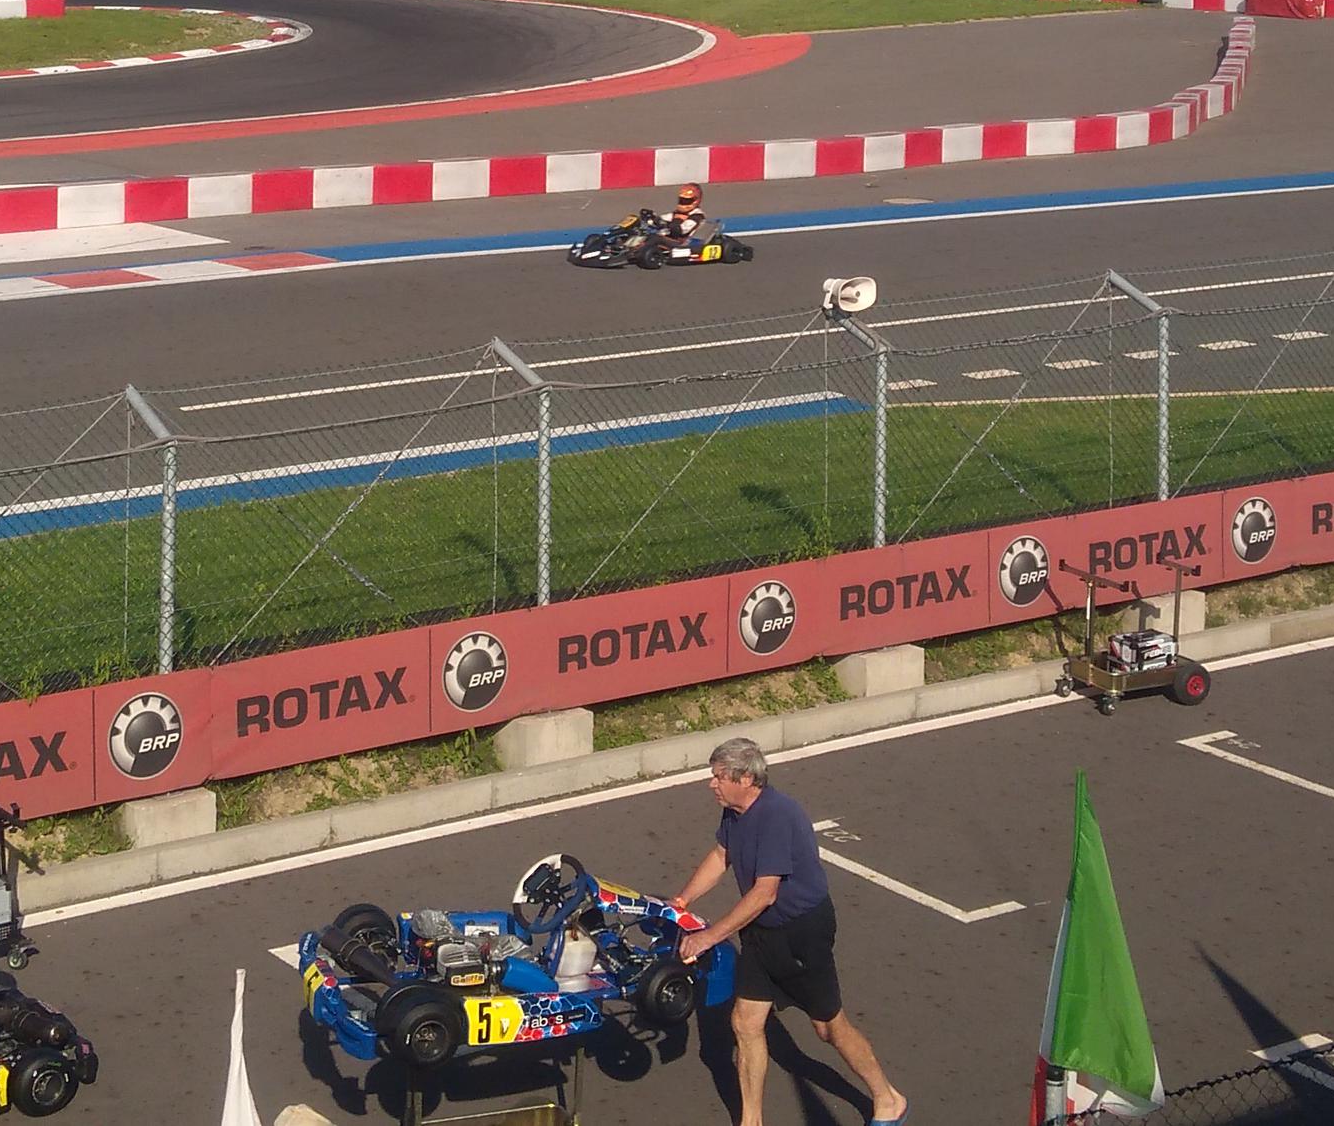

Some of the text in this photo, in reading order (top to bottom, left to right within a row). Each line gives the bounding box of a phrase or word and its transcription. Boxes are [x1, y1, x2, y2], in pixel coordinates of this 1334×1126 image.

[1089, 524, 1207, 575] ROTAX
[1249, 528, 1275, 544] BRP
[1019, 569, 1047, 586] BRP
[839, 565, 972, 622] ROTAX
[761, 616, 794, 633] BRP
[558, 612, 708, 674] ROTAX
[468, 669, 505, 689] BRP
[236, 667, 408, 738] ROTAX
[138, 732, 180, 754] BRP
[478, 1002, 492, 1043] 5
